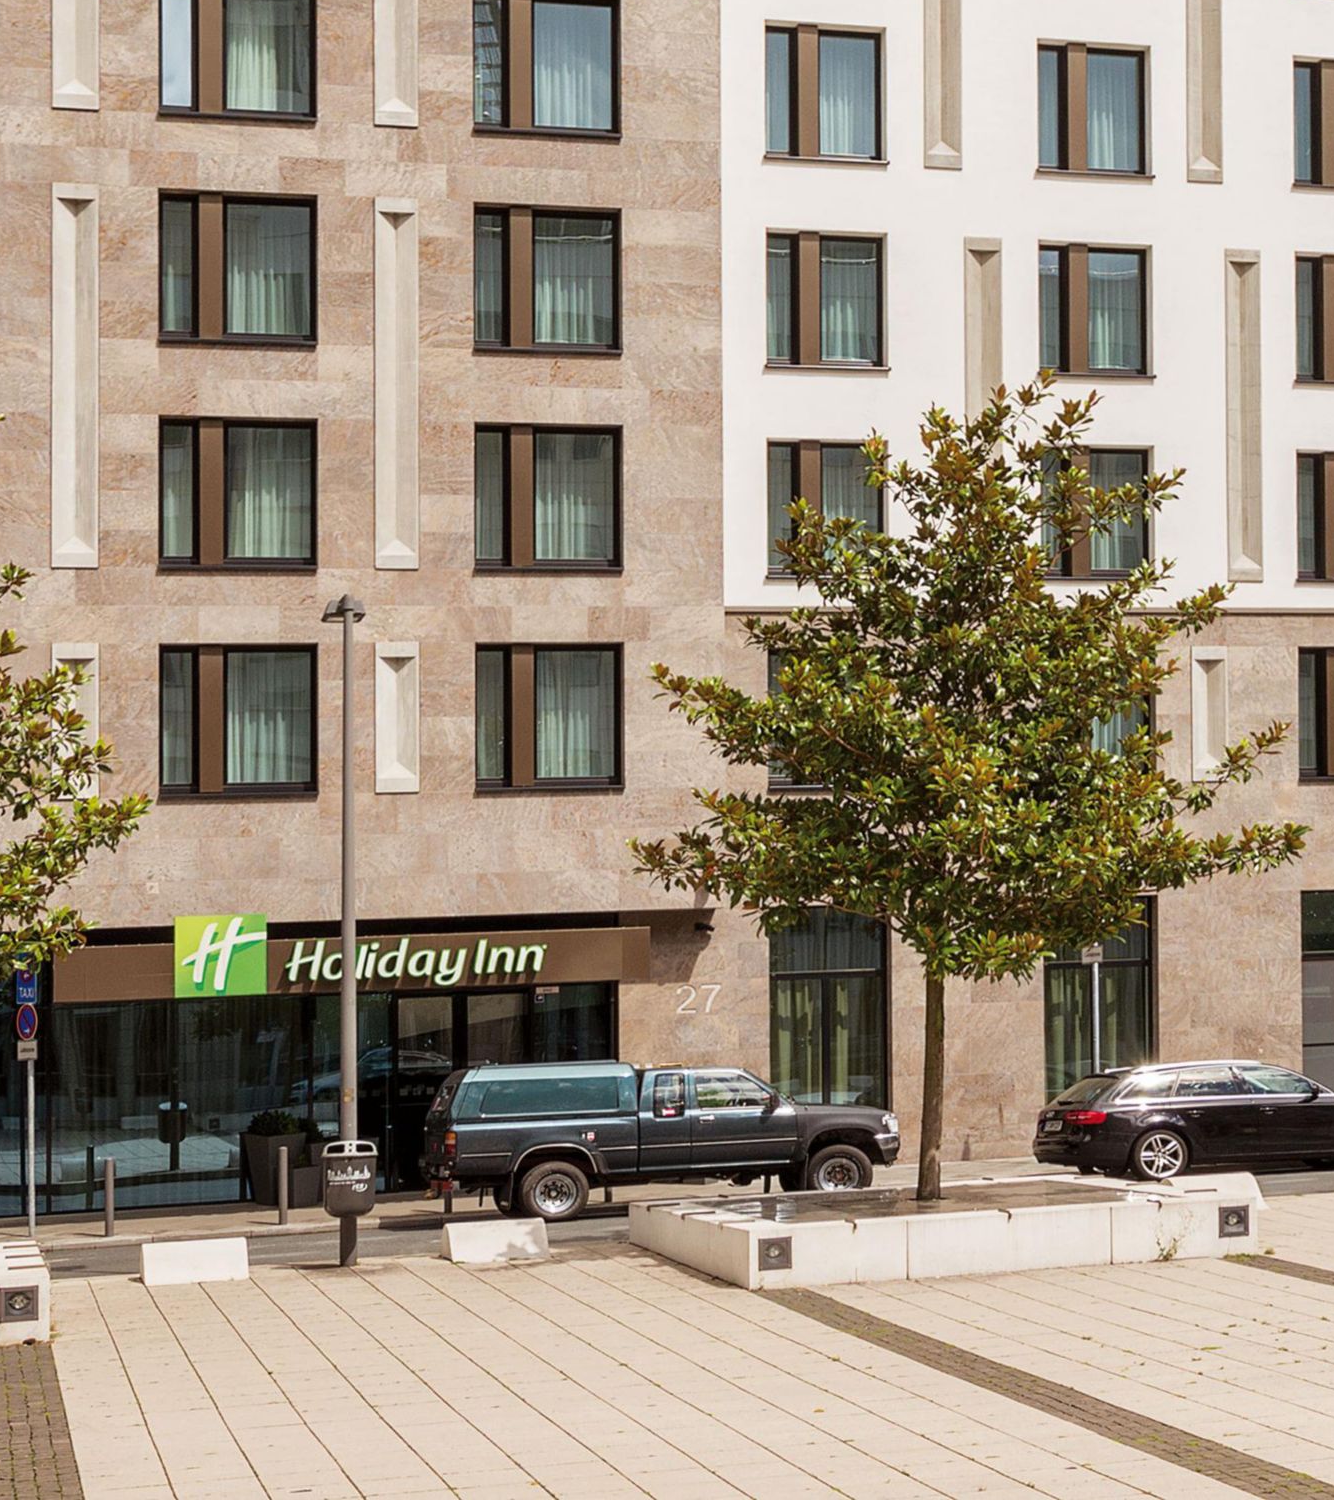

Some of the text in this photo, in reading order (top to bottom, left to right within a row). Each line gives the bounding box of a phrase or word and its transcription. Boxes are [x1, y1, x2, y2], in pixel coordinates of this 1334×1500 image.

[285, 938, 545, 987] Holiday Inn
[19, 987, 35, 998] TAXI
[676, 985, 721, 1013] 27
